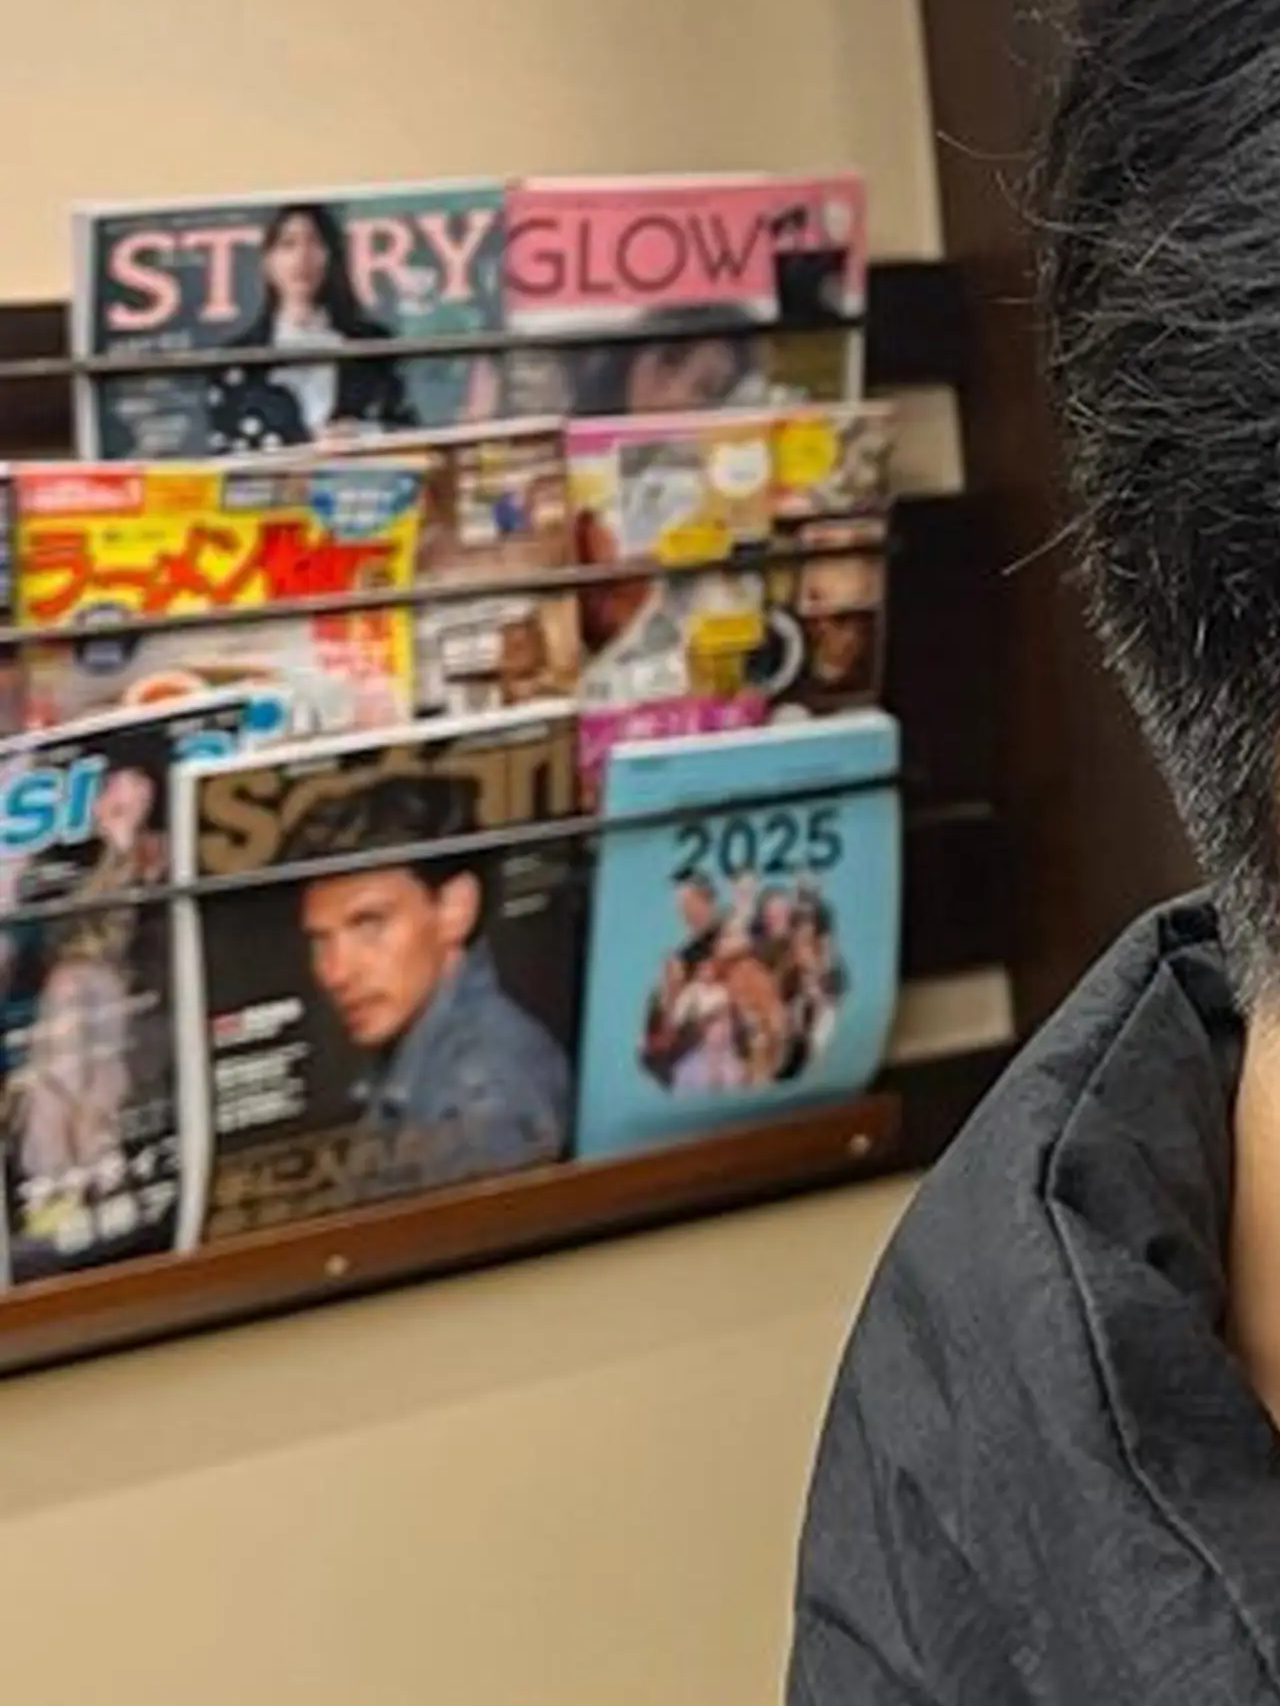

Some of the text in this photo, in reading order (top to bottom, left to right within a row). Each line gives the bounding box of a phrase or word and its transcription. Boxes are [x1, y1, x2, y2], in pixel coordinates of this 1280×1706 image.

[106, 207, 496, 332] STRY
[504, 212, 771, 295] GLOW
[669, 806, 844, 883] 2025
